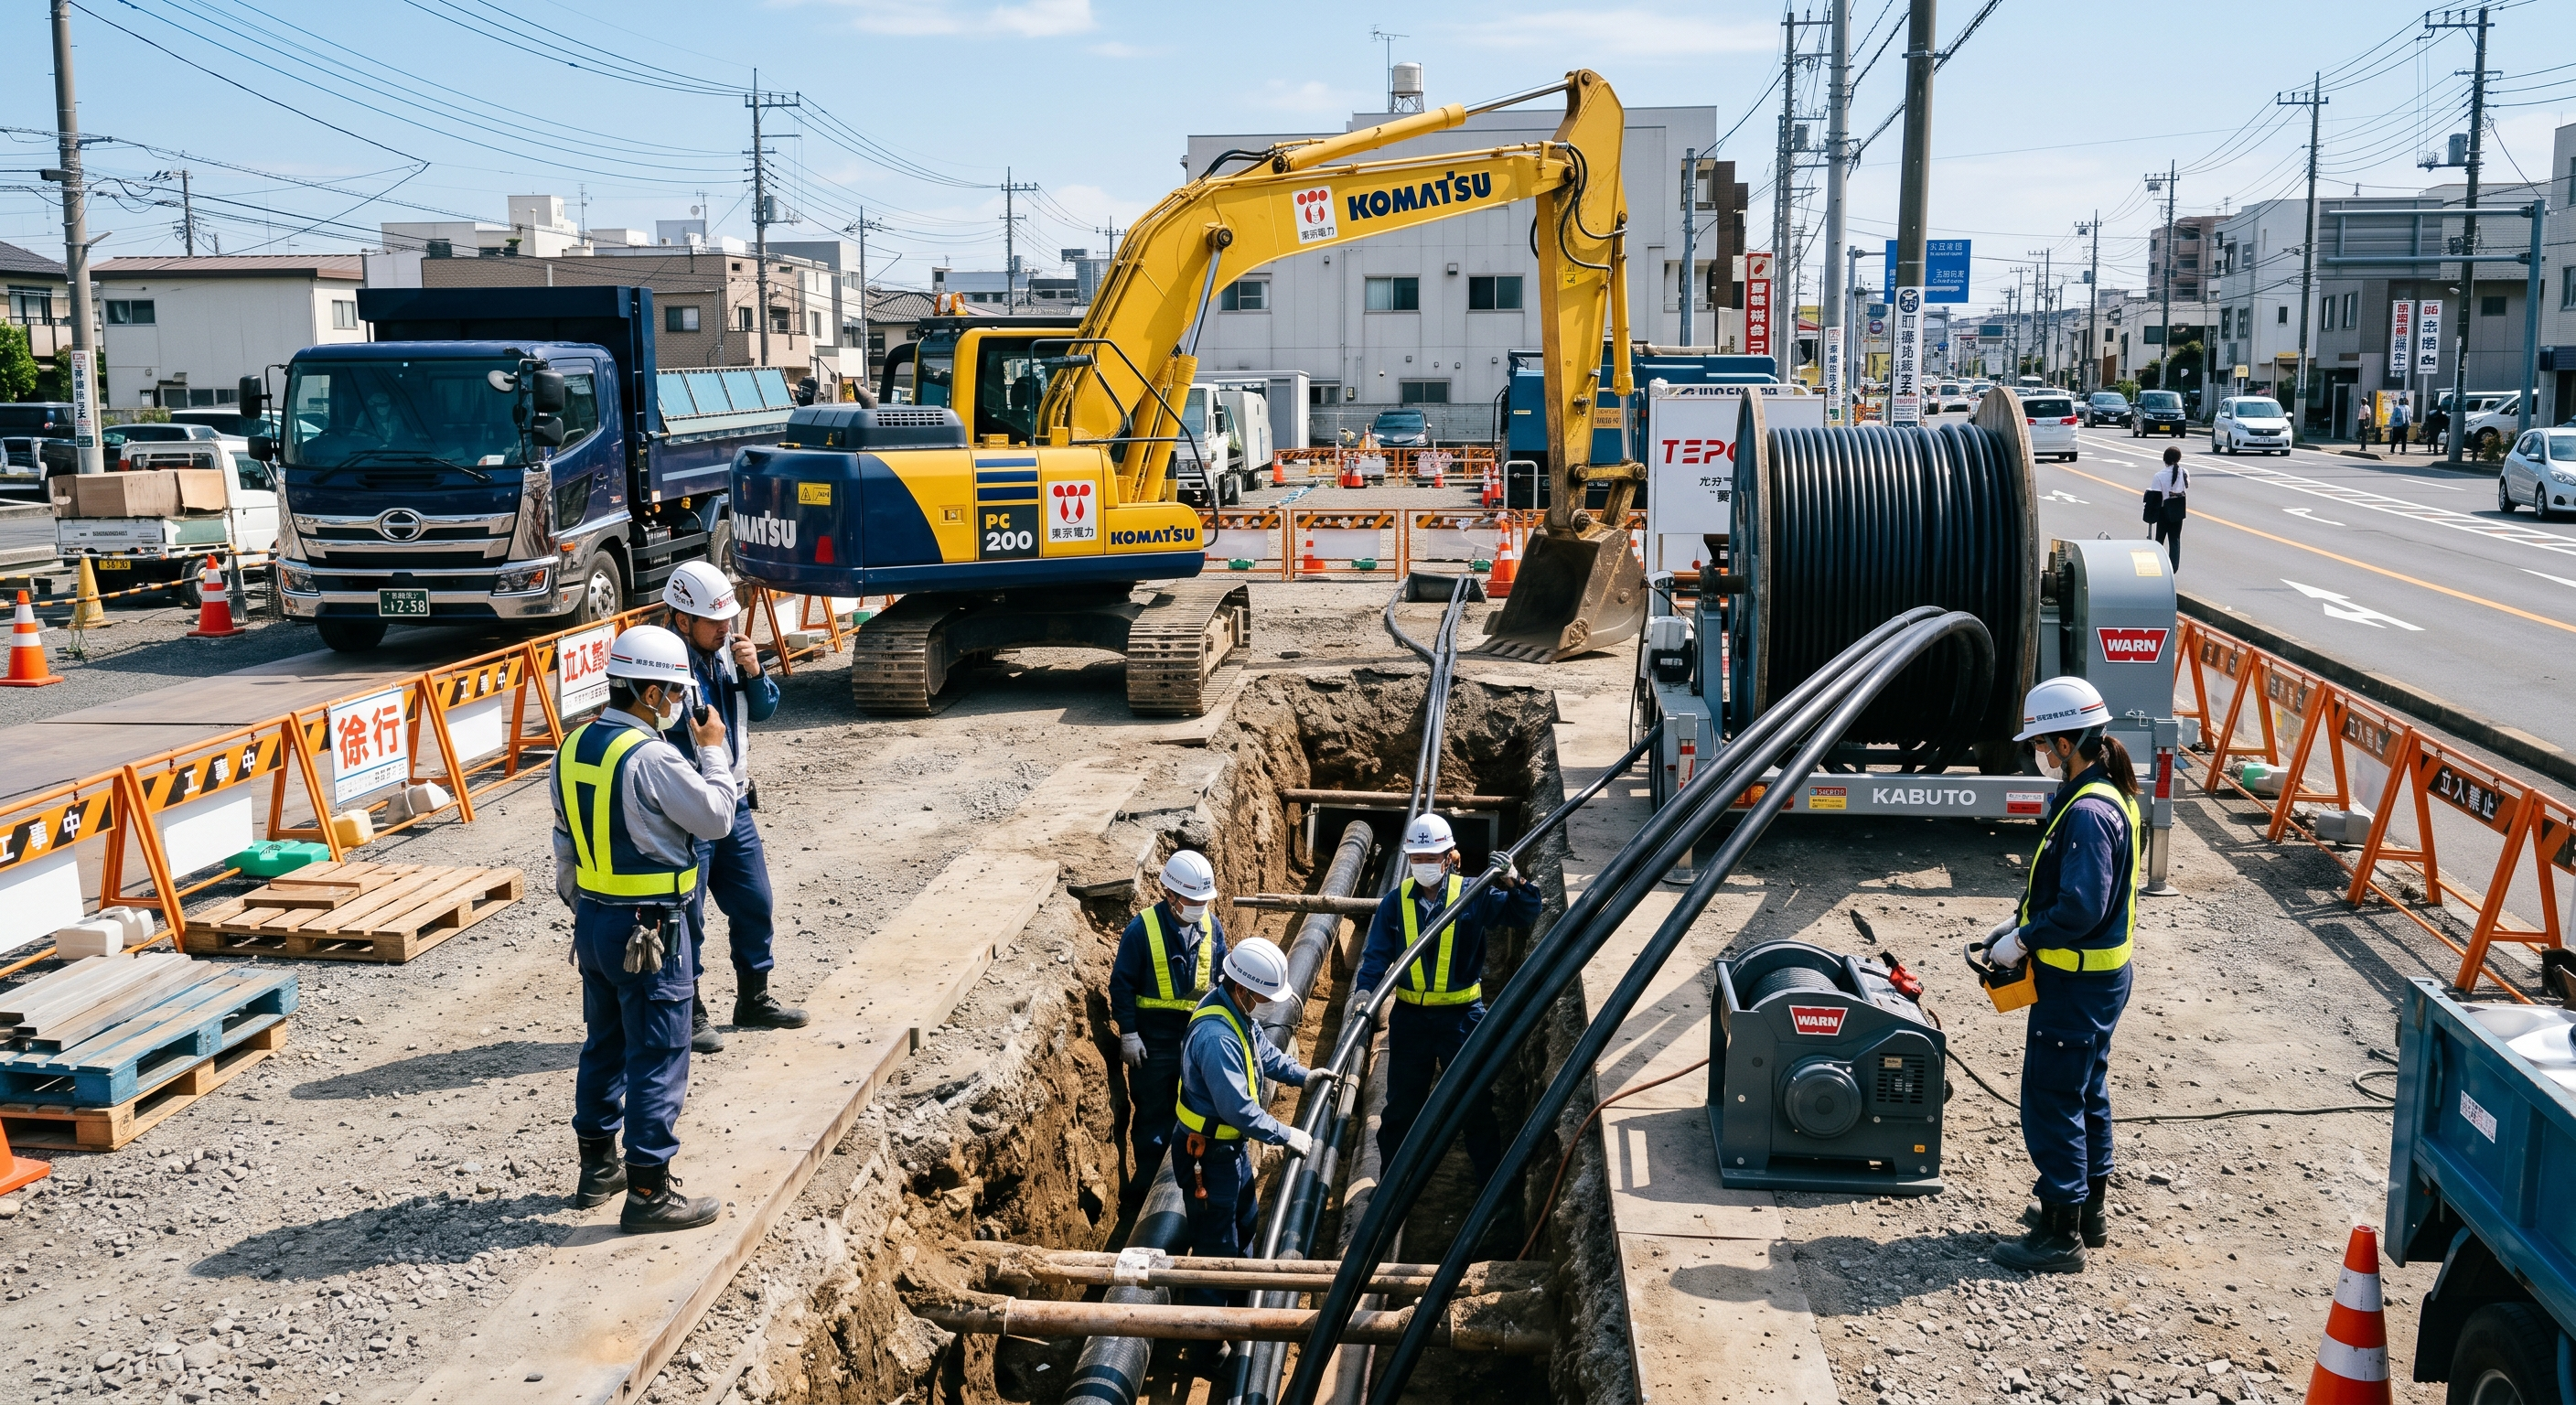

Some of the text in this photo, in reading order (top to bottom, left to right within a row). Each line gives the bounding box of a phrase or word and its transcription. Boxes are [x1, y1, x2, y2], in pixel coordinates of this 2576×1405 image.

[1347, 171, 1492, 221] KOMATSU
[733, 509, 797, 549] OMATSU
[985, 513, 1010, 530] PC
[986, 531, 1033, 552] 200
[1111, 525, 1195, 544] KOMATSU
[2107, 638, 2157, 652] WARN
[338, 704, 401, 769] 徐行
[184, 749, 255, 795] 工事中
[1873, 788, 1976, 806] KABUTO
[1798, 1015, 1838, 1026] WARN
